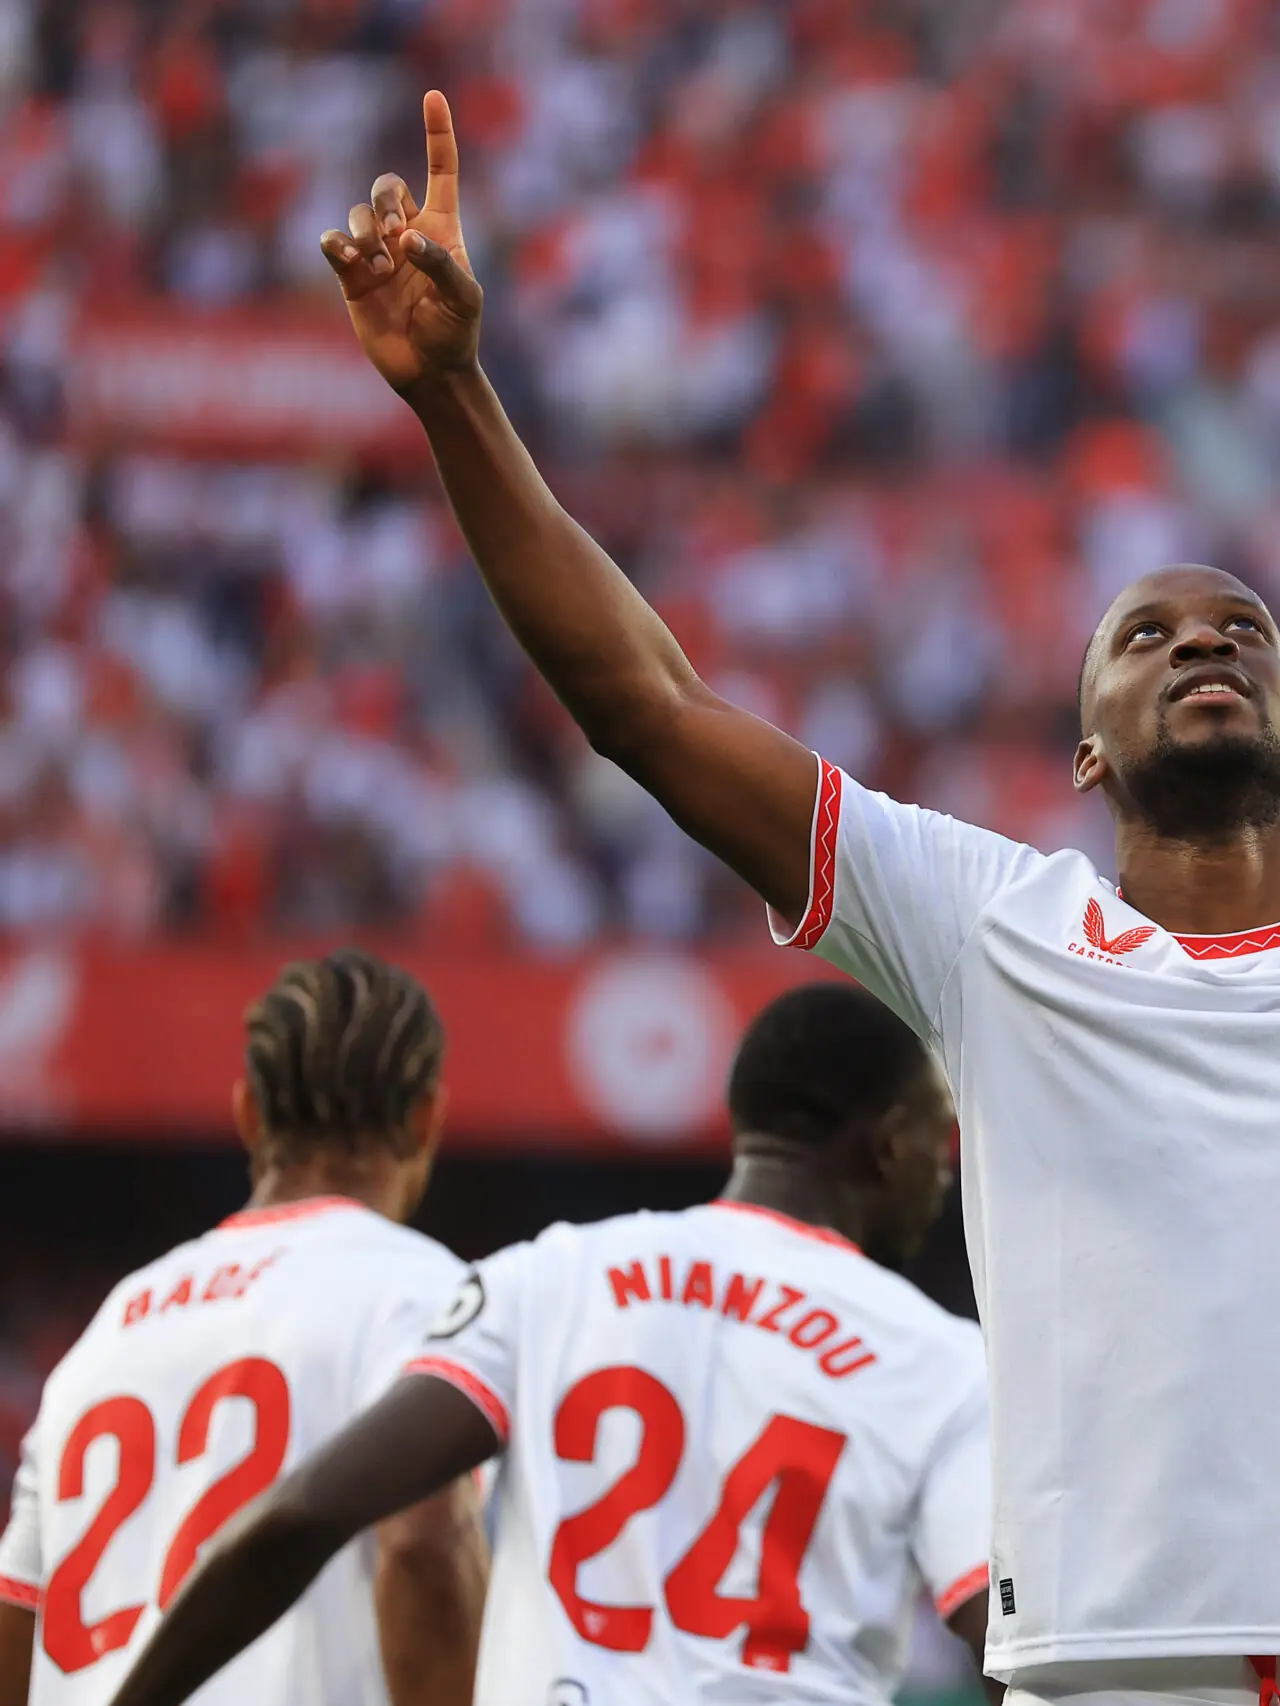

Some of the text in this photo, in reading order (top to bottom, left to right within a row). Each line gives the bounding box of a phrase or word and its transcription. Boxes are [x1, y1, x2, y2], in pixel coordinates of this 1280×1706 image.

[608, 1256, 876, 1378] NIANZOU
[41, 1357, 291, 1673] 22
[548, 1365, 846, 1673] 24
